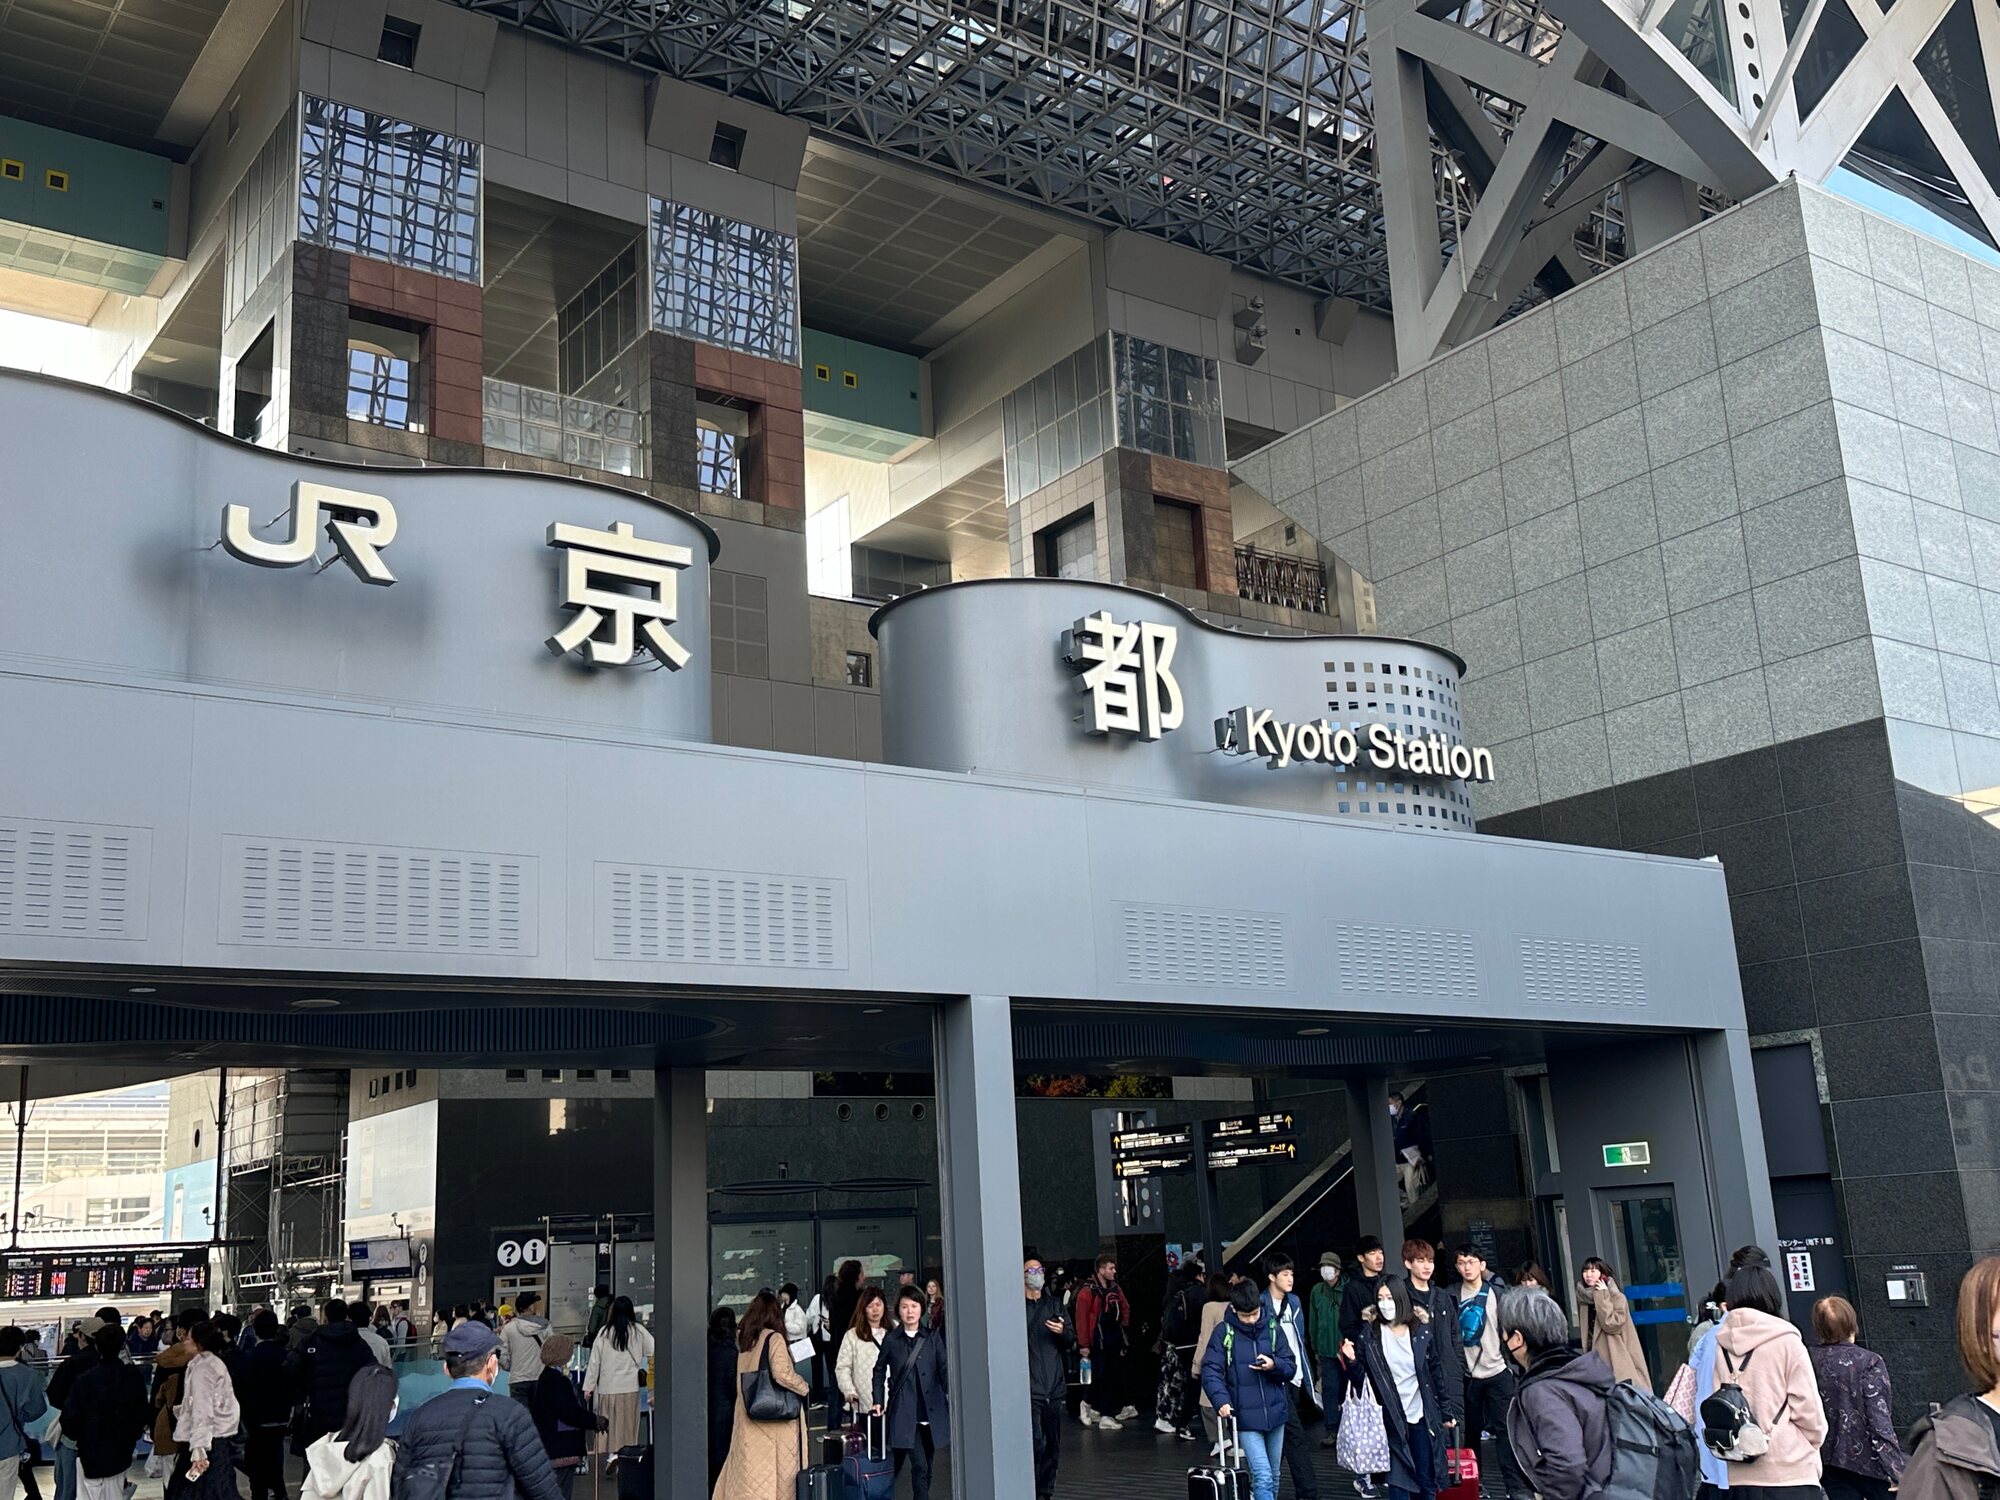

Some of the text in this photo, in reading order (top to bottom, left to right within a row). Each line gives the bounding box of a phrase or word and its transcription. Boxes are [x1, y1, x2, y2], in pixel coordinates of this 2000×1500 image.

[222, 480, 1184, 742] JR 京 都
[1241, 707, 1495, 782] Kyoto Station
